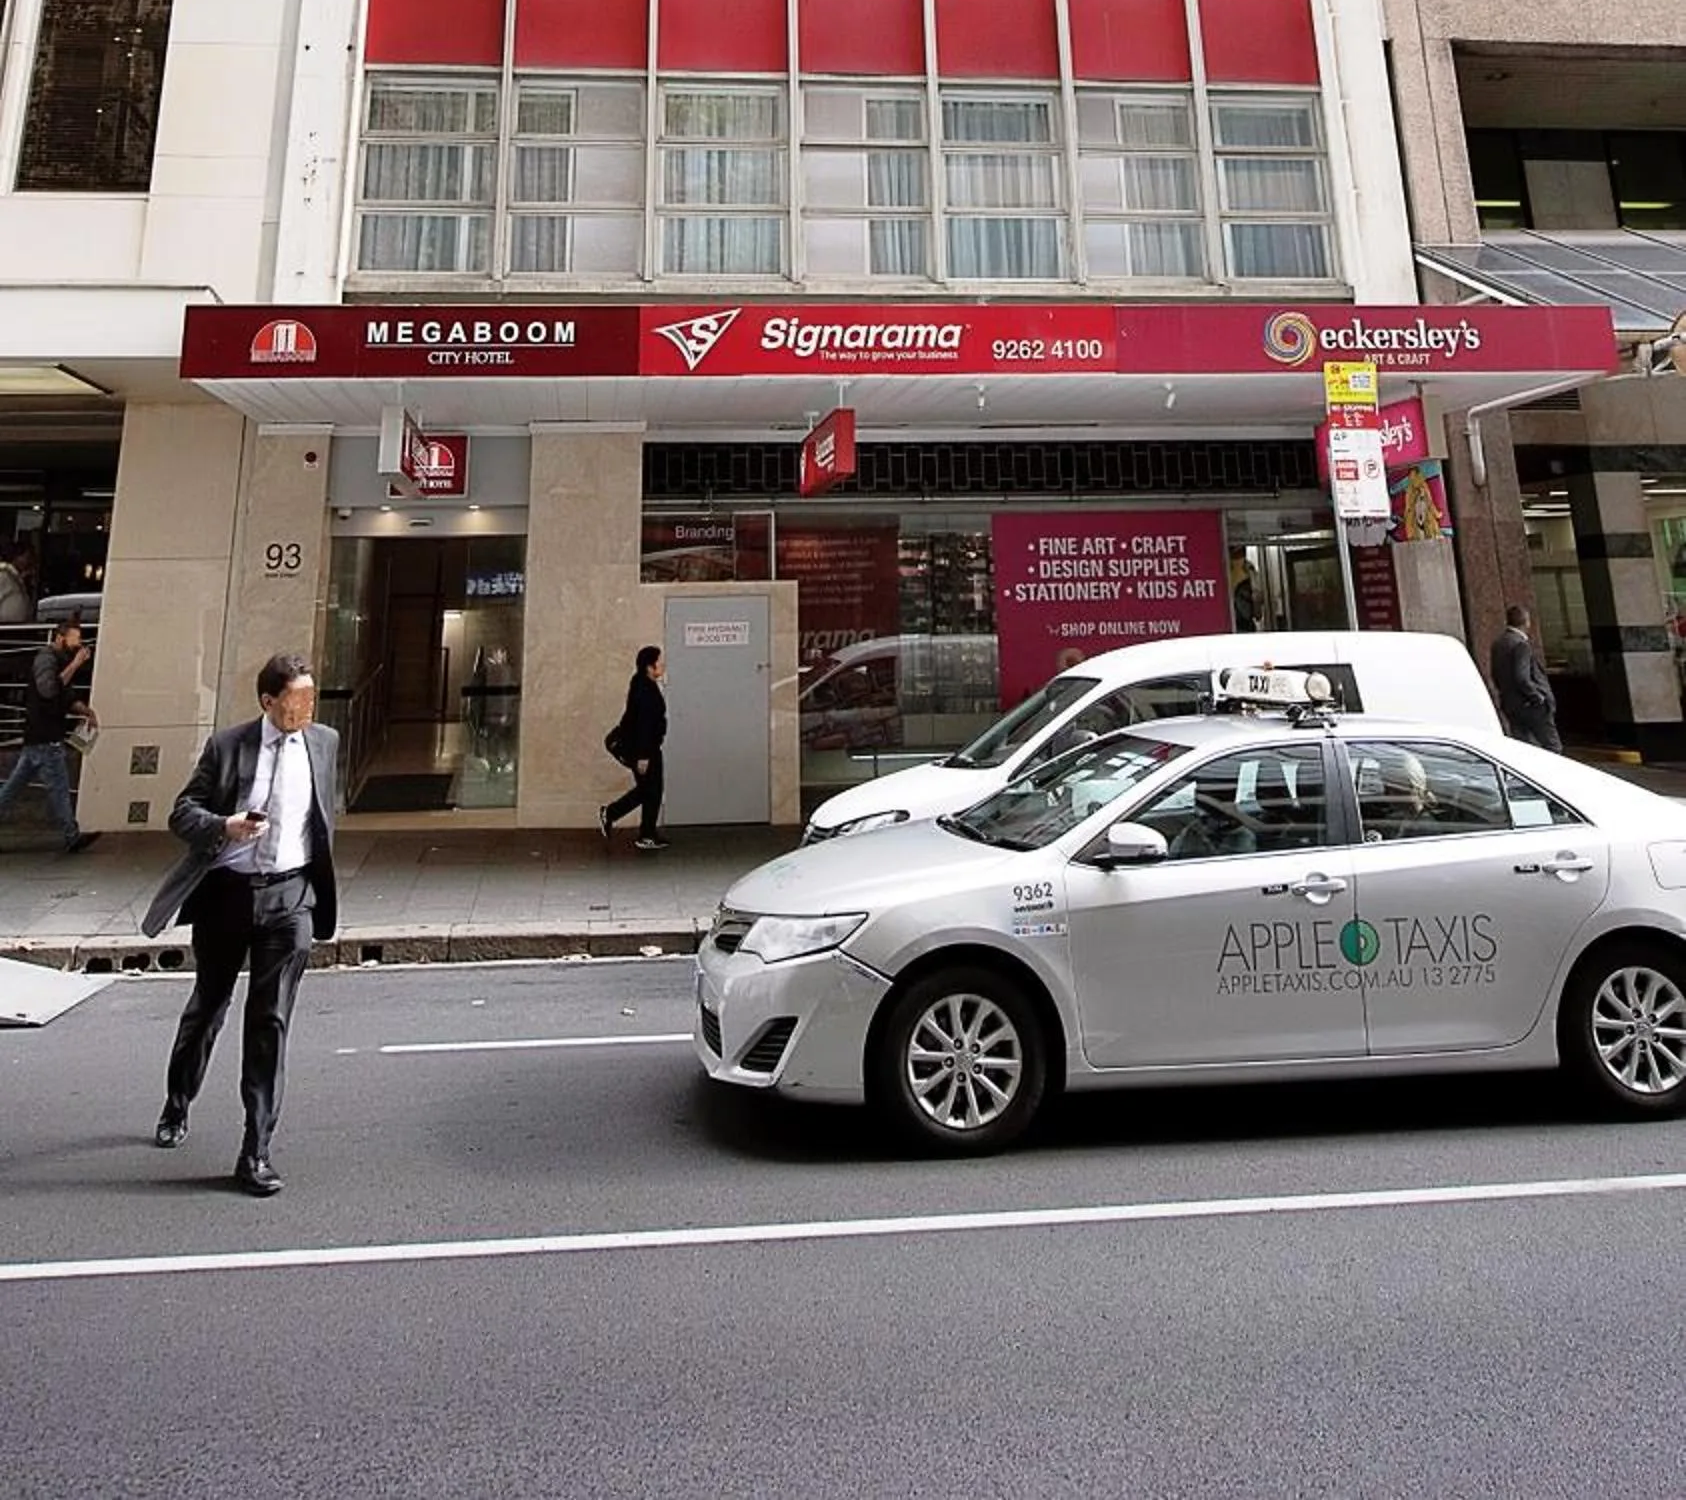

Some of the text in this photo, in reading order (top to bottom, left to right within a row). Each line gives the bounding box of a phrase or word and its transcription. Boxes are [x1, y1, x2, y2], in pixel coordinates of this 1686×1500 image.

[366, 321, 576, 343] MEGABOOM
[761, 317, 963, 357] Signarama
[1319, 317, 1481, 358] eckersley's
[427, 351, 514, 365] CITY HOTEL
[820, 350, 960, 363] The way to grow your business
[992, 339, 1103, 359] 9262 4100
[1386, 354, 1396, 365] &
[1397, 353, 1431, 365] CRAFT
[675, 524, 735, 542] Branding
[1038, 535, 1188, 556] FINE ART CRAFT
[265, 543, 302, 570] 93
[1039, 558, 1191, 579] DESIGN SUPPLIES
[1014, 579, 1217, 602] STATIONERY KIDS ART
[1060, 620, 1181, 637] SHOP ONLINE NOW
[1248, 674, 1271, 694] TAXI
[1013, 881, 1054, 901] 9362
[1217, 913, 1497, 973] APPLE TAXIS
[1216, 964, 1496, 995] APPLETAXIS.COM.AU 13 2775
